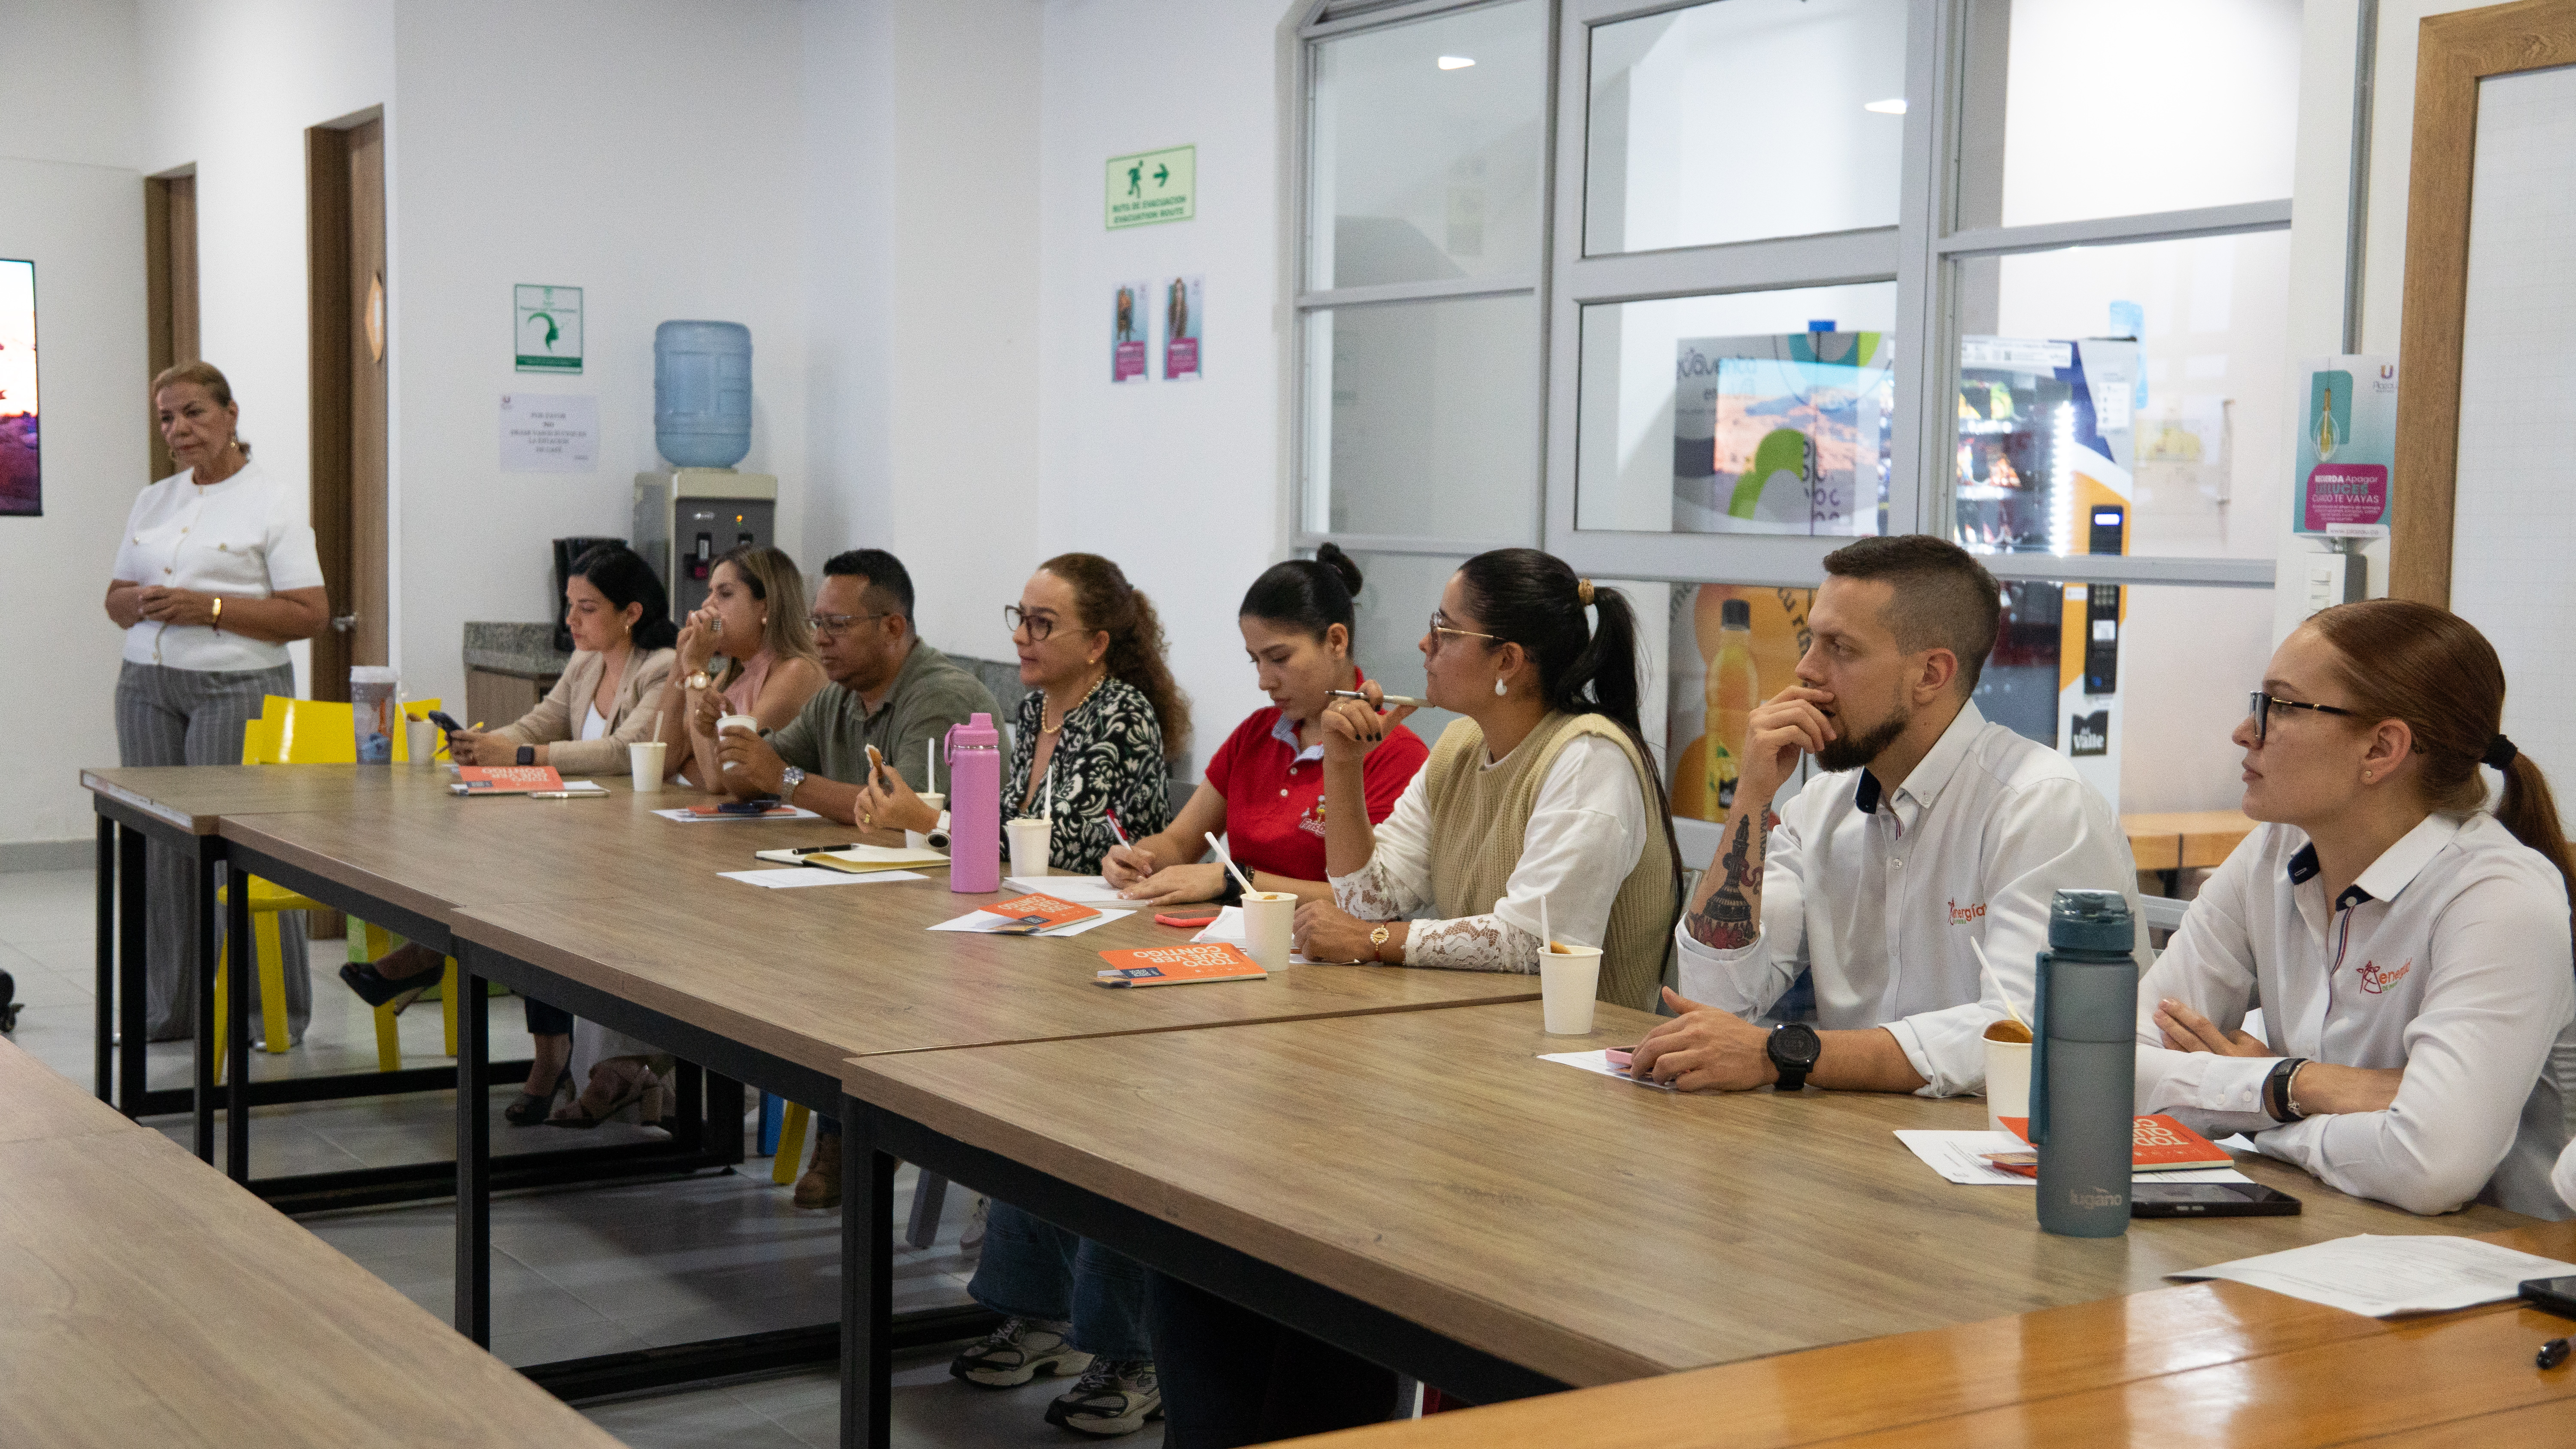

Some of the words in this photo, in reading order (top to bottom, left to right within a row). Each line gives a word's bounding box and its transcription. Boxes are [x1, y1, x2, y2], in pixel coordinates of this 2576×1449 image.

[2345, 476, 2378, 484] Apagar
[2334, 494, 2344, 503] TE
[2346, 495, 2379, 503] VAYAS
[2073, 734, 2104, 750] Valle
[1299, 817, 1326, 836] Frisb
[1133, 946, 1221, 958] CONTIGO
[1188, 952, 1230, 960] QUE
[1182, 958, 1239, 967] TODO
[2133, 1127, 2173, 1137] QU
[2133, 1136, 2189, 1146] TOD
[2070, 1188, 2122, 1210] lugano
